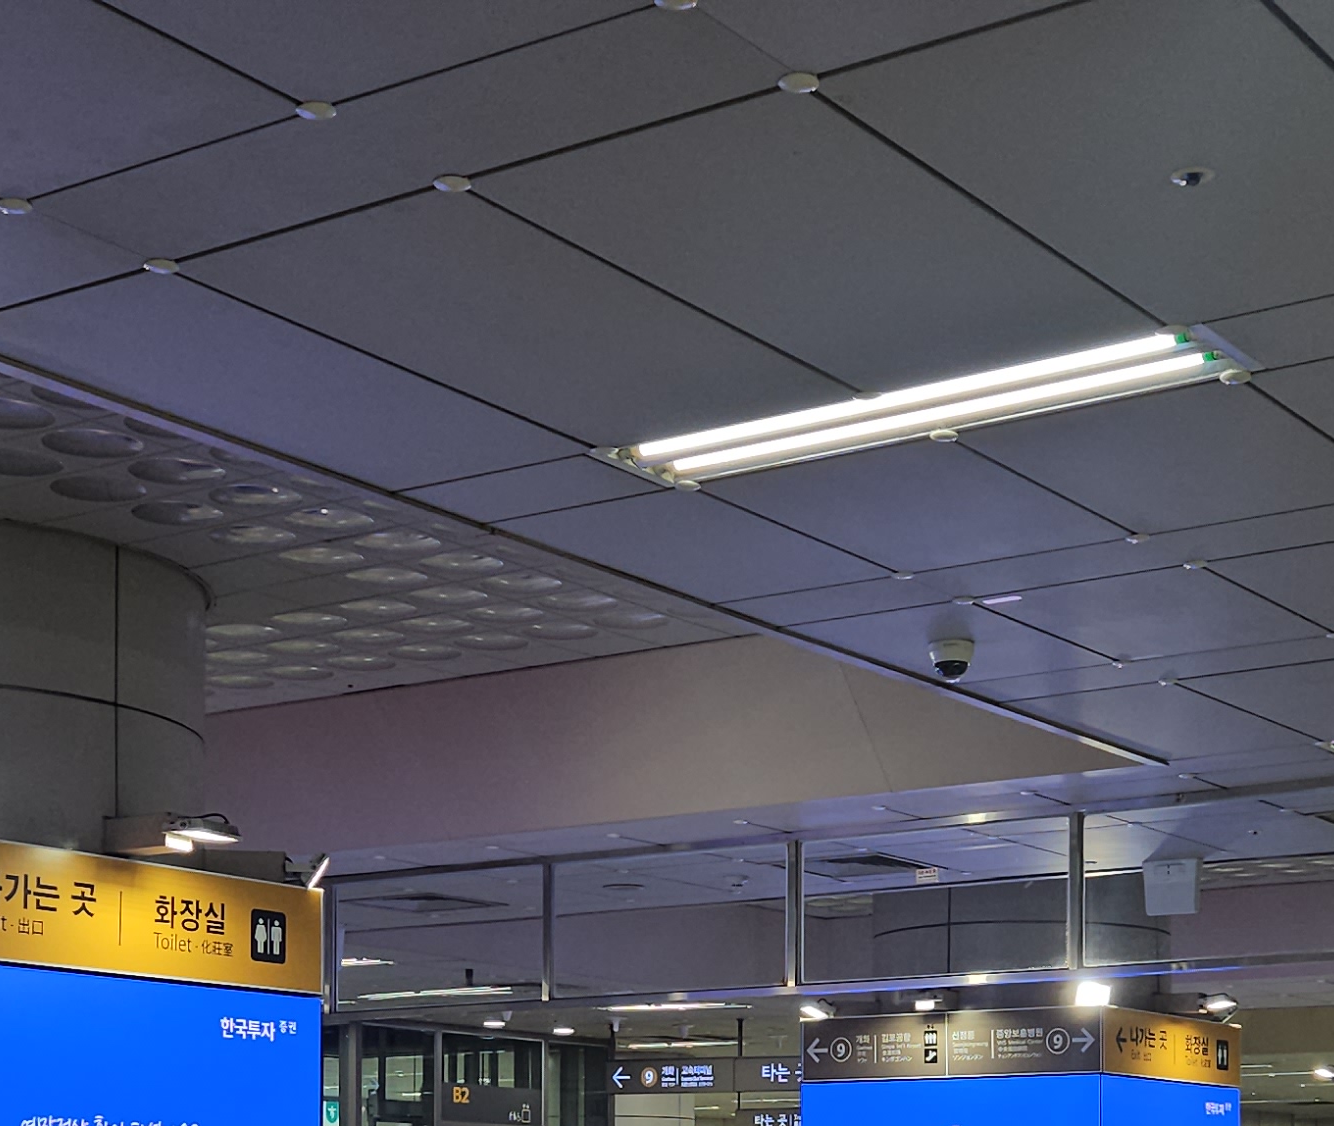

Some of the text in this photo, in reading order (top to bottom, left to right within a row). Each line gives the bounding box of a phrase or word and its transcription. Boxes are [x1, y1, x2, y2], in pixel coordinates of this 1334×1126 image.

[71, 880, 97, 918] 곳
[17, 917, 45, 936] 出口
[154, 895, 227, 936] 화장실
[153, 931, 193, 954] Toilet
[220, 1016, 298, 1042] 한국투자 증권
[1130, 1026, 1168, 1050] 나가는 곳
[1185, 1034, 1209, 1056] 화장실
[643, 1070, 654, 1085] 9
[761, 1063, 791, 1083] 타는
[452, 1086, 470, 1103] B2
